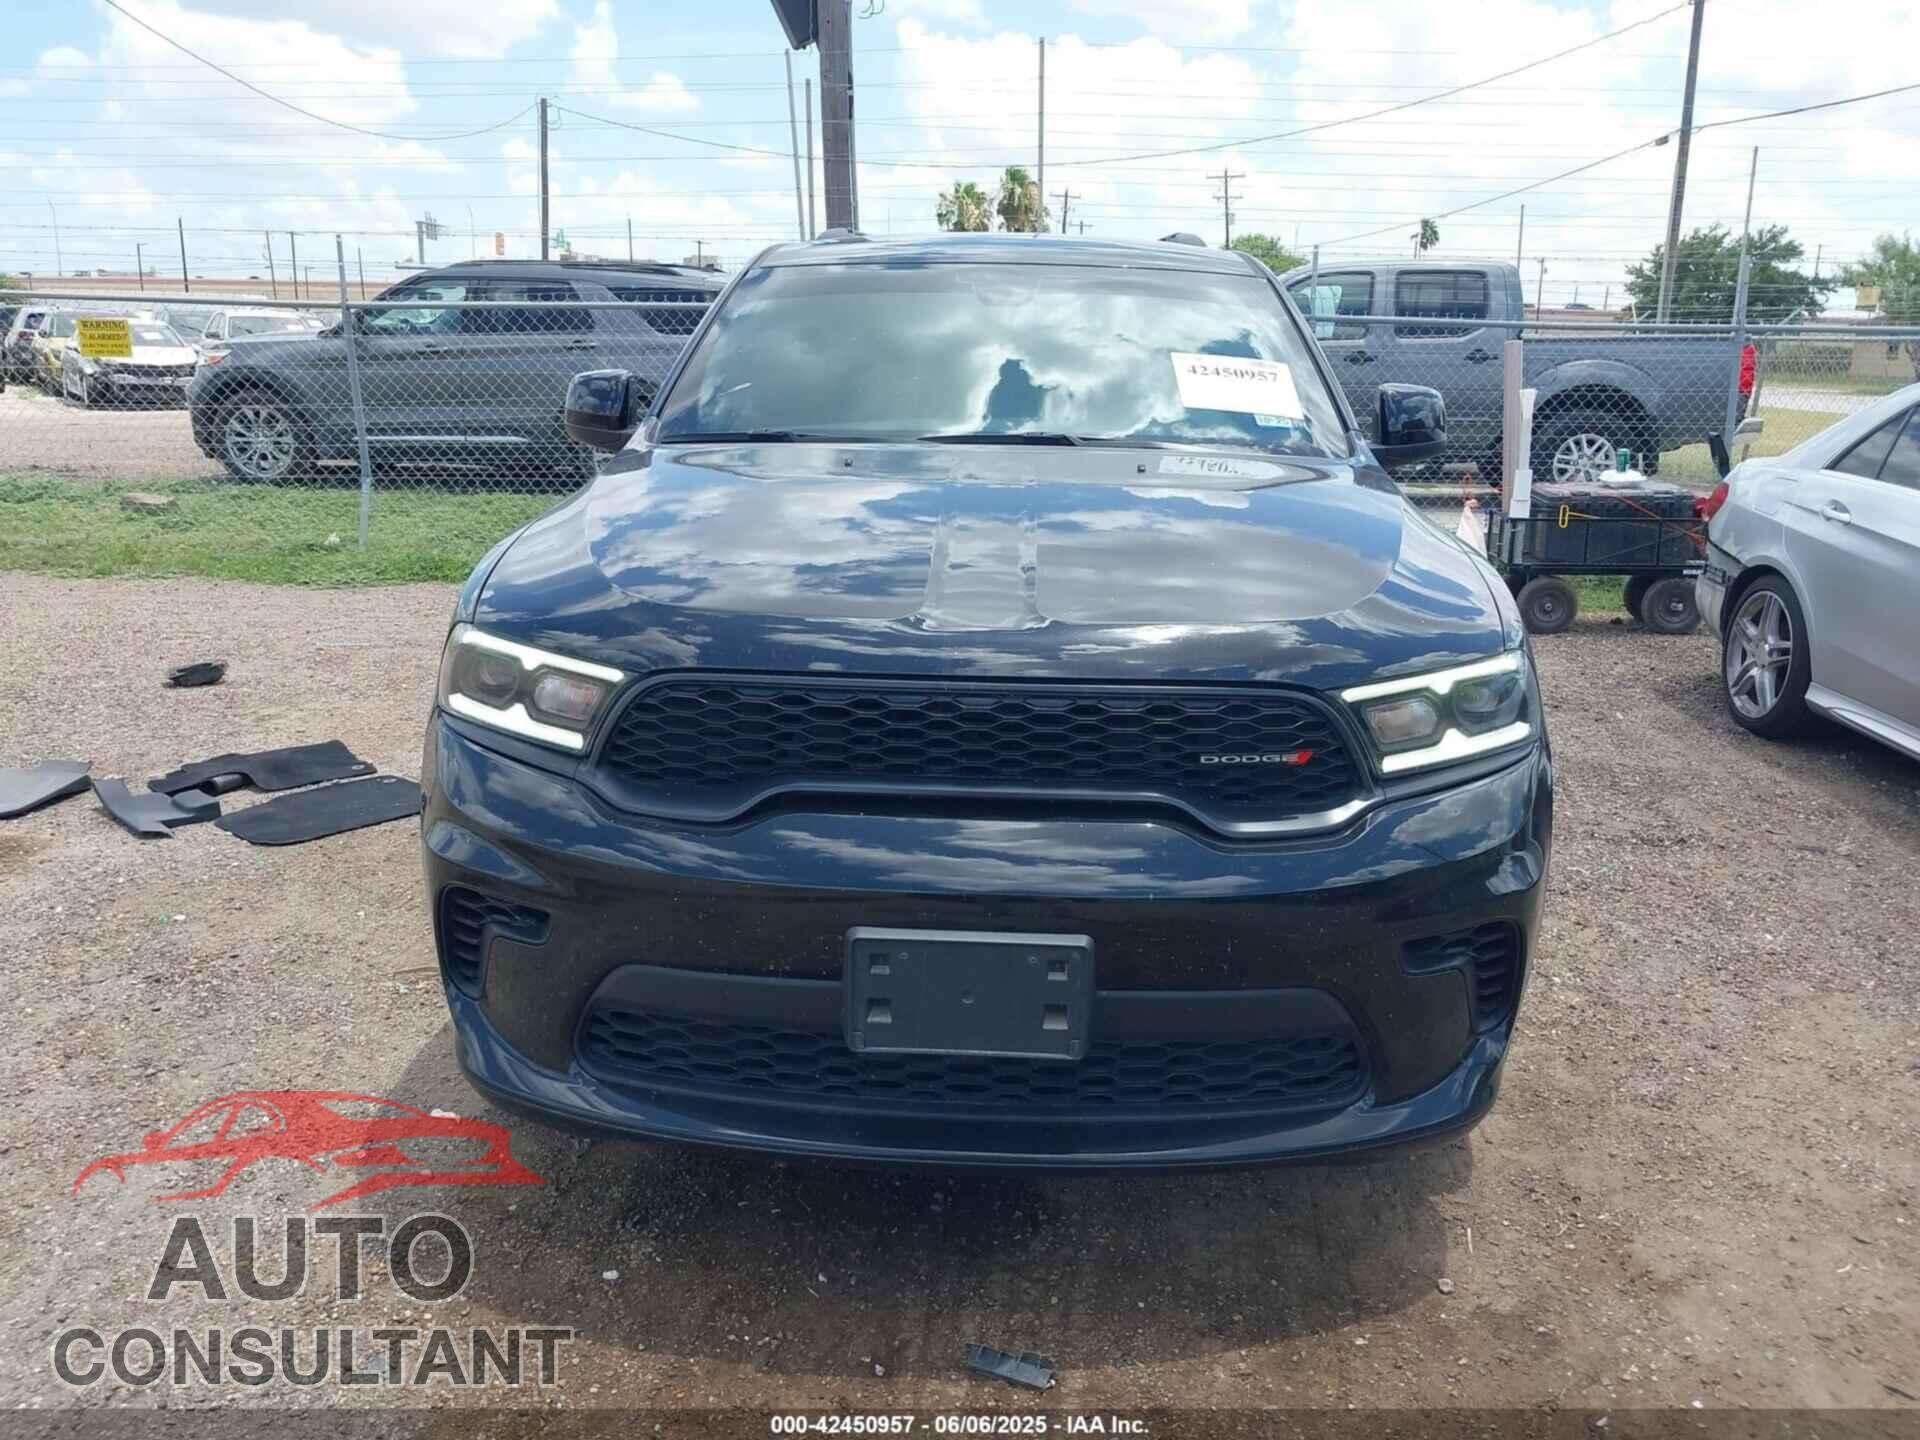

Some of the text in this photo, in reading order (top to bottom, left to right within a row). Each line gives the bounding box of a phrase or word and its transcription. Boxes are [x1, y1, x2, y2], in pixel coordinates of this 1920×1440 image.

[80, 319, 125, 329] WARNING
[1186, 364, 1278, 383] 42450957
[1200, 753, 1299, 764] DODGE
